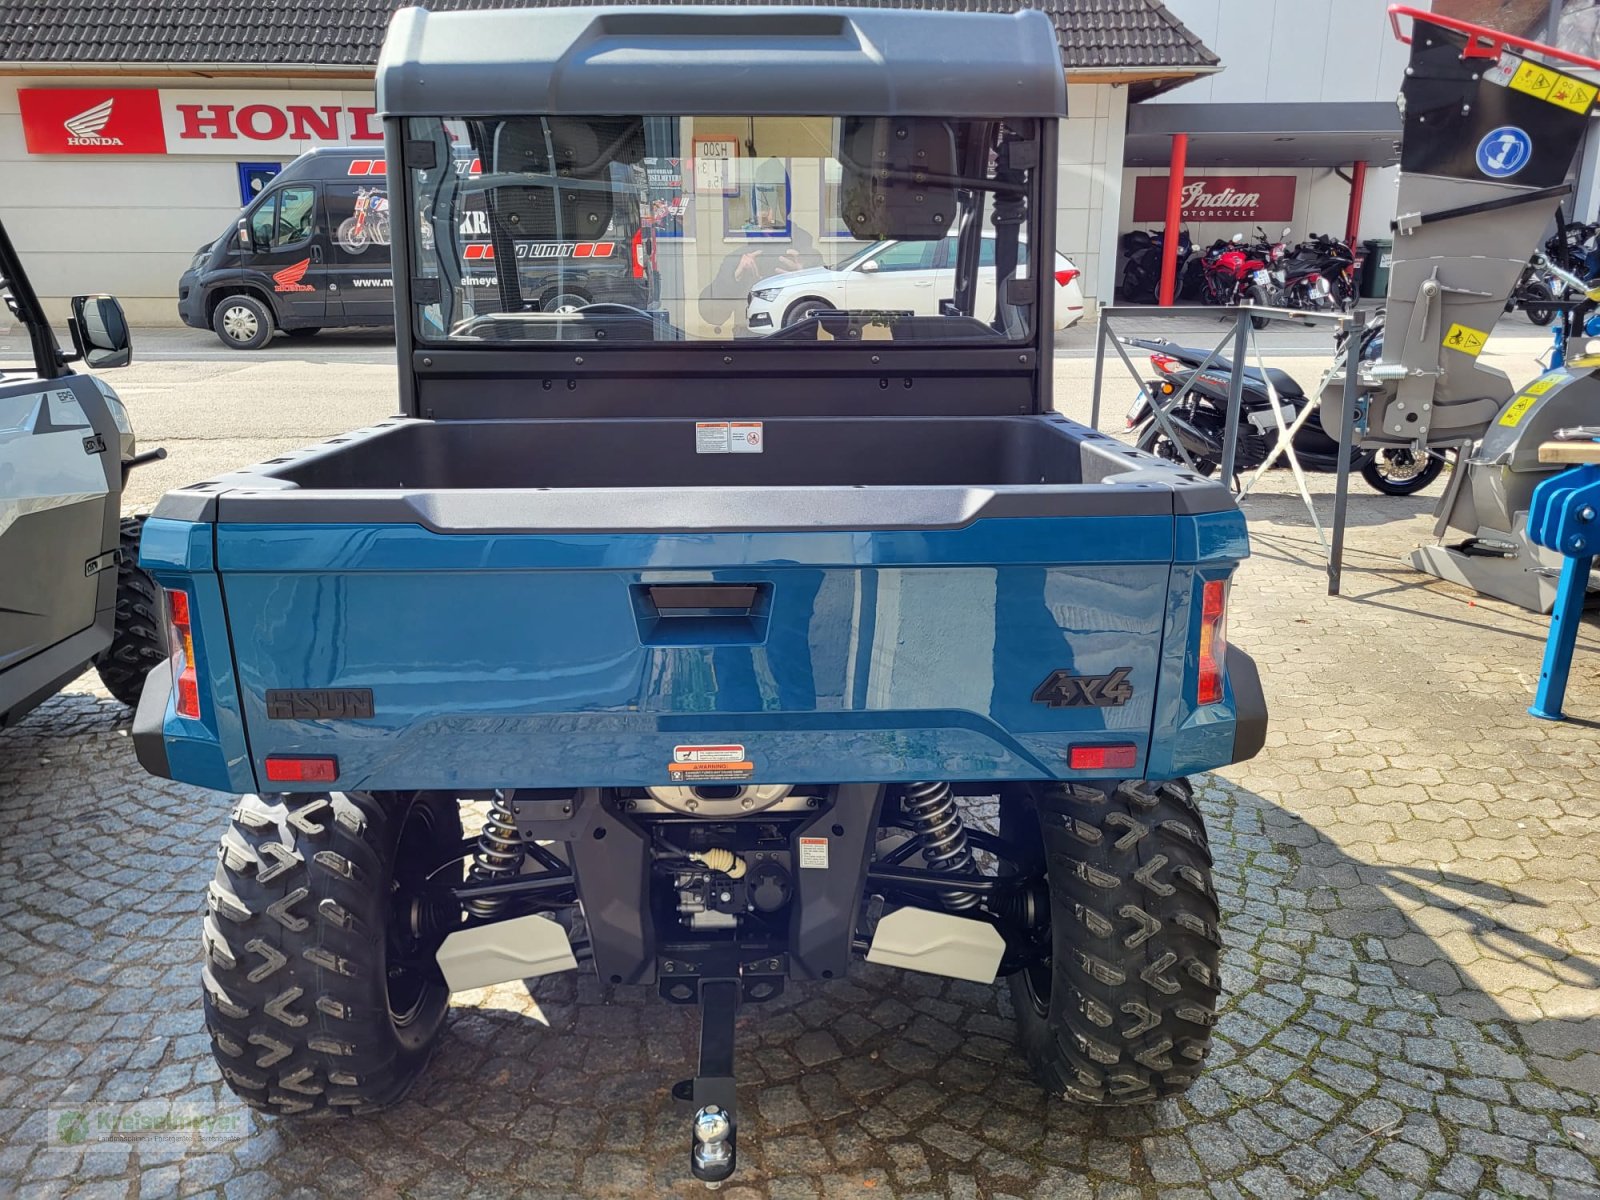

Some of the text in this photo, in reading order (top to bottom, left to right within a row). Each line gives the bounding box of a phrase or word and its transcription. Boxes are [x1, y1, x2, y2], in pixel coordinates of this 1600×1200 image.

[67, 137, 124, 146] HONDA
[1181, 181, 1260, 208] Indian
[529, 243, 575, 258] LIMIT
[352, 276, 498, 287] www.m elmeye
[56, 390, 76, 402] EPS
